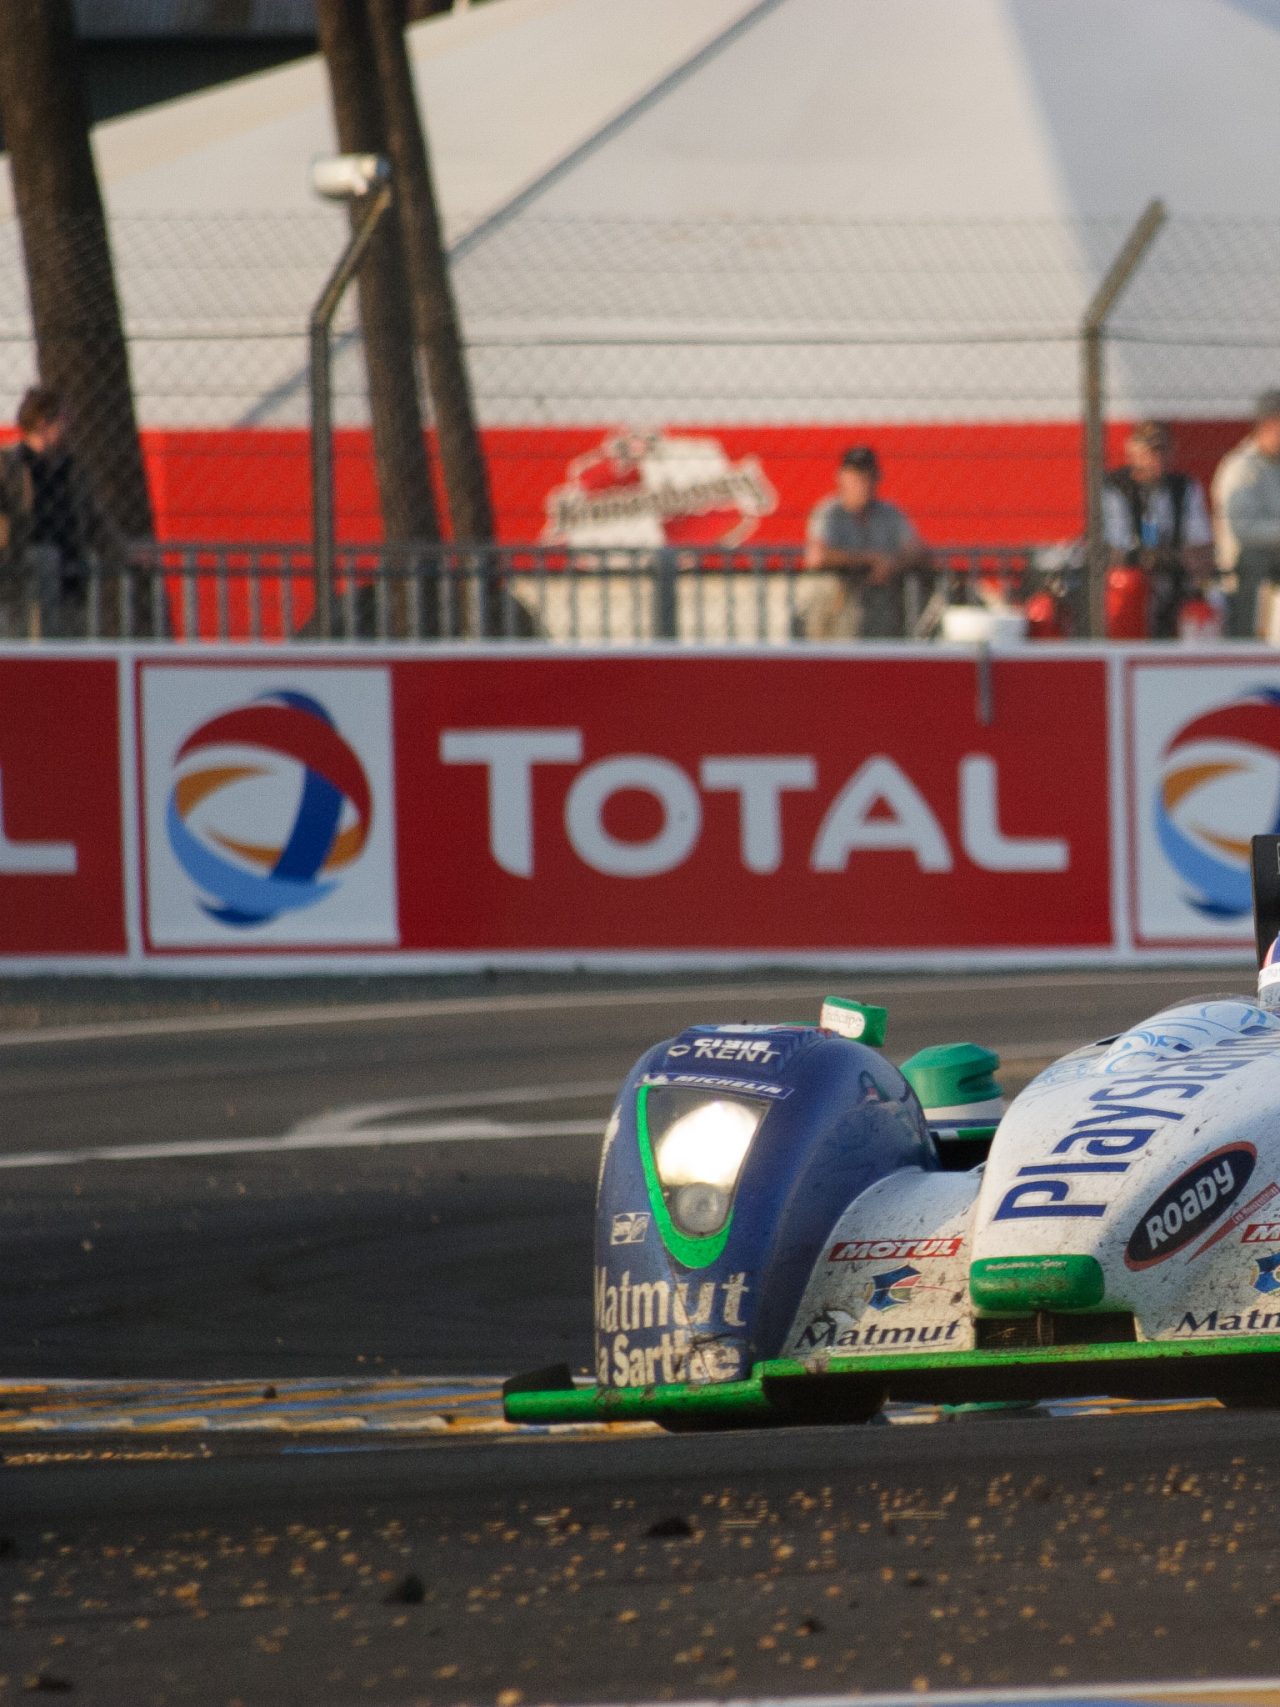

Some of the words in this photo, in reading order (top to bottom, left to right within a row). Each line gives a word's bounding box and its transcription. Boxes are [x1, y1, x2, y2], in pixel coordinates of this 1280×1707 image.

[439, 728, 1069, 879] TOTAL
[695, 1046, 781, 1064] KENT
[673, 1074, 782, 1095] MICHELIN
[835, 1239, 956, 1260] MOTUL
[794, 1319, 961, 1348] Matmut
